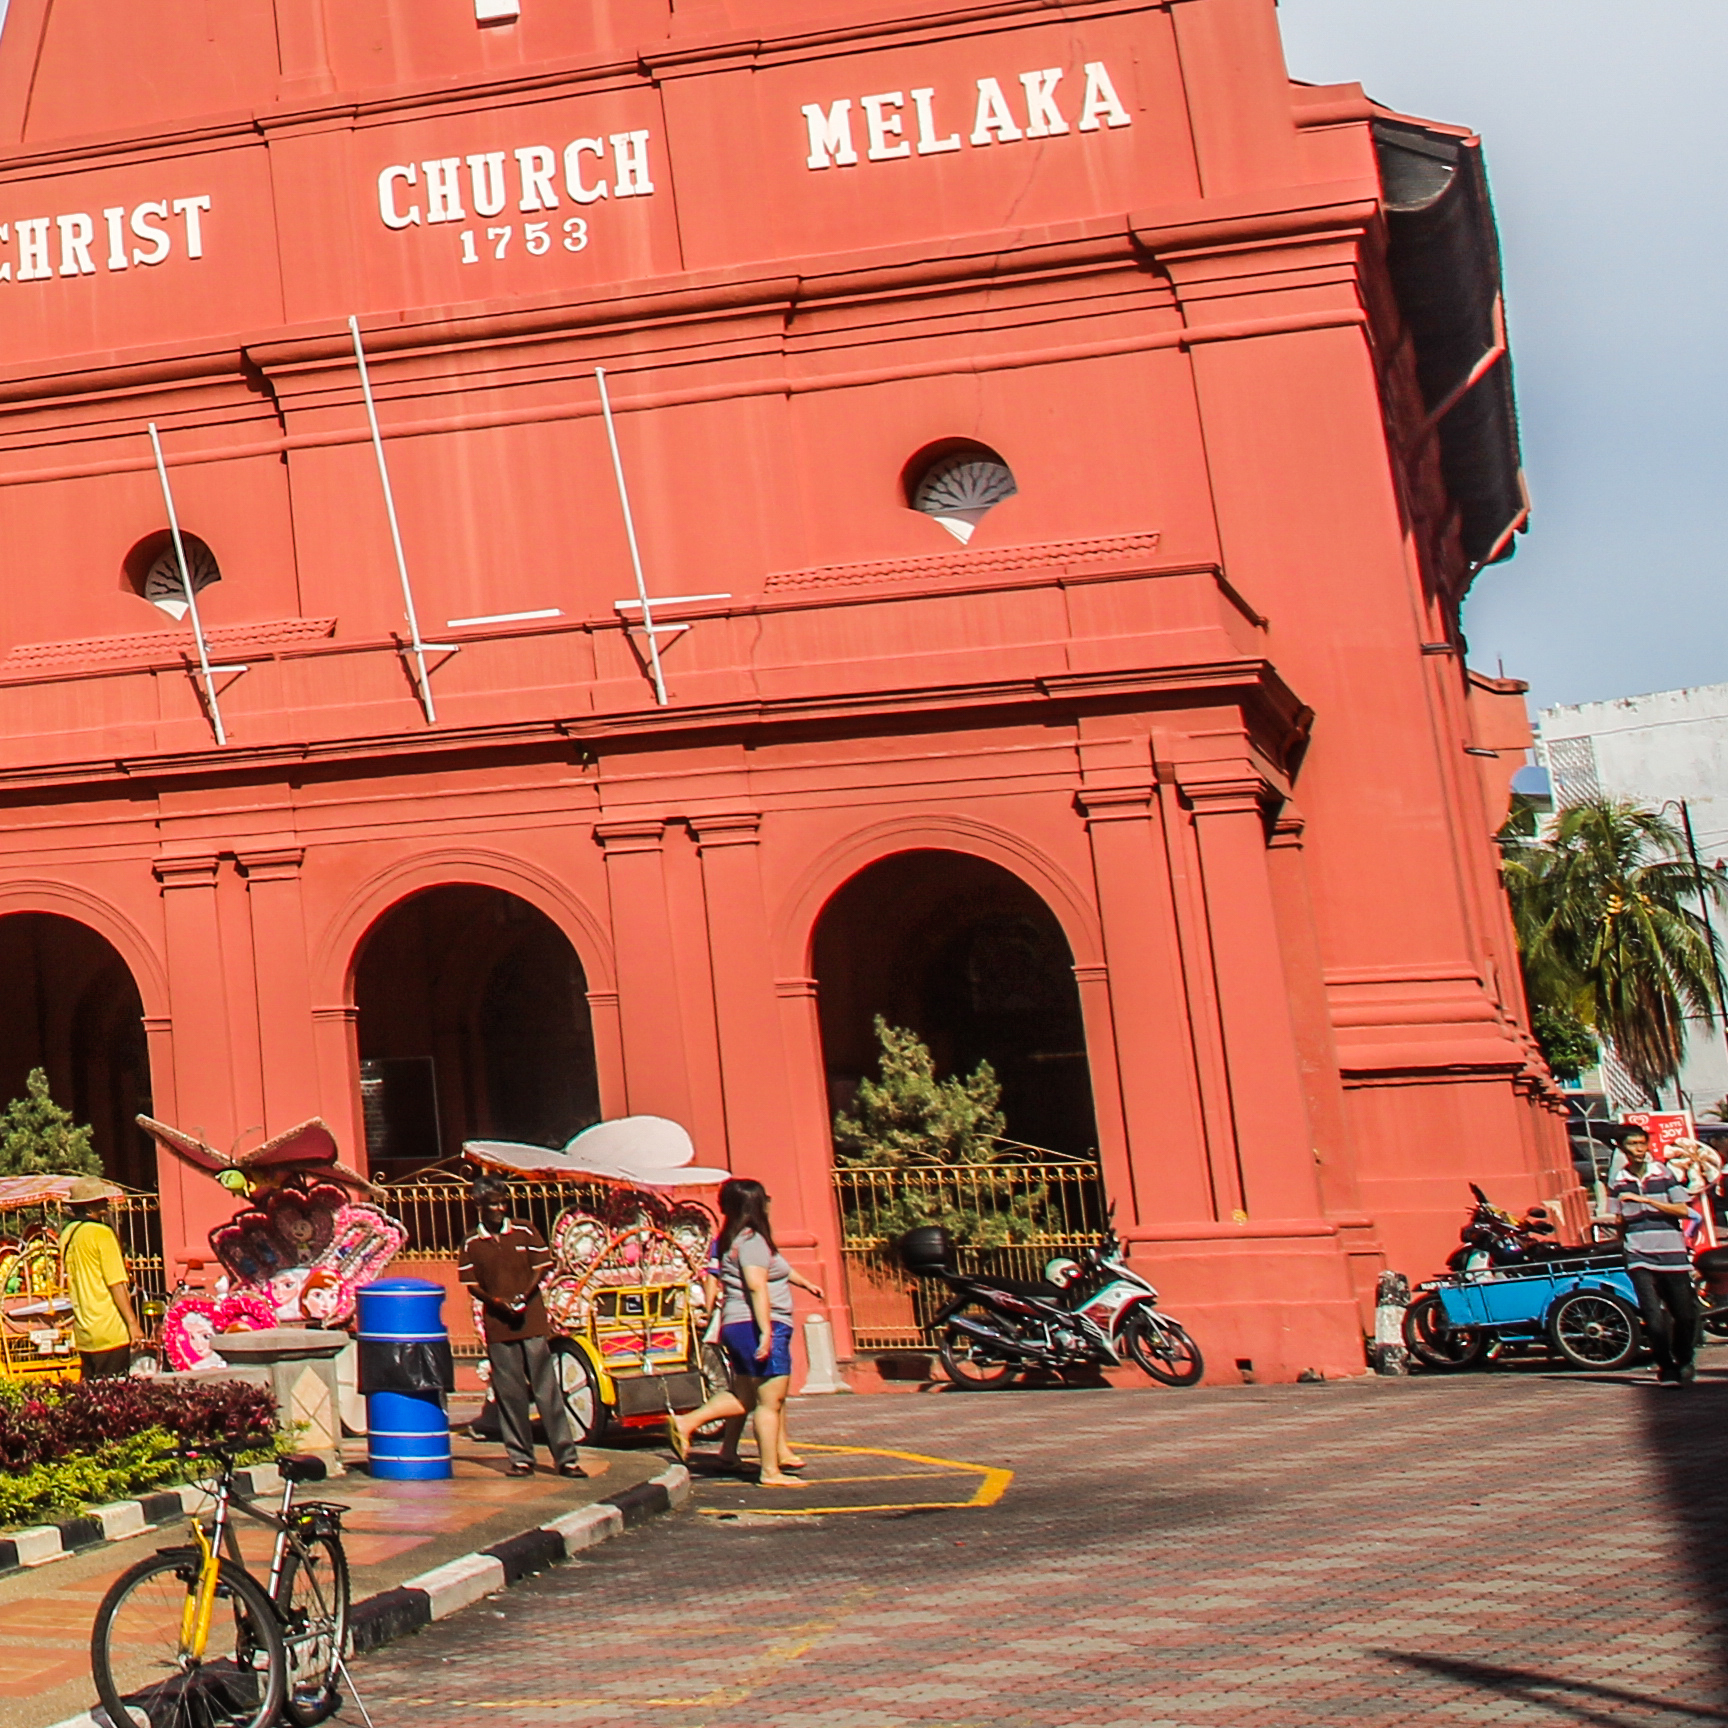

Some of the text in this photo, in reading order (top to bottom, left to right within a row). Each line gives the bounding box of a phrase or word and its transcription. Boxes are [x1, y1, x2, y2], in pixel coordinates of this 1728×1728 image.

[376, 128, 656, 229] CHURCH
[800, 60, 1133, 170] MELAKA
[459, 216, 589, 265] 1753
